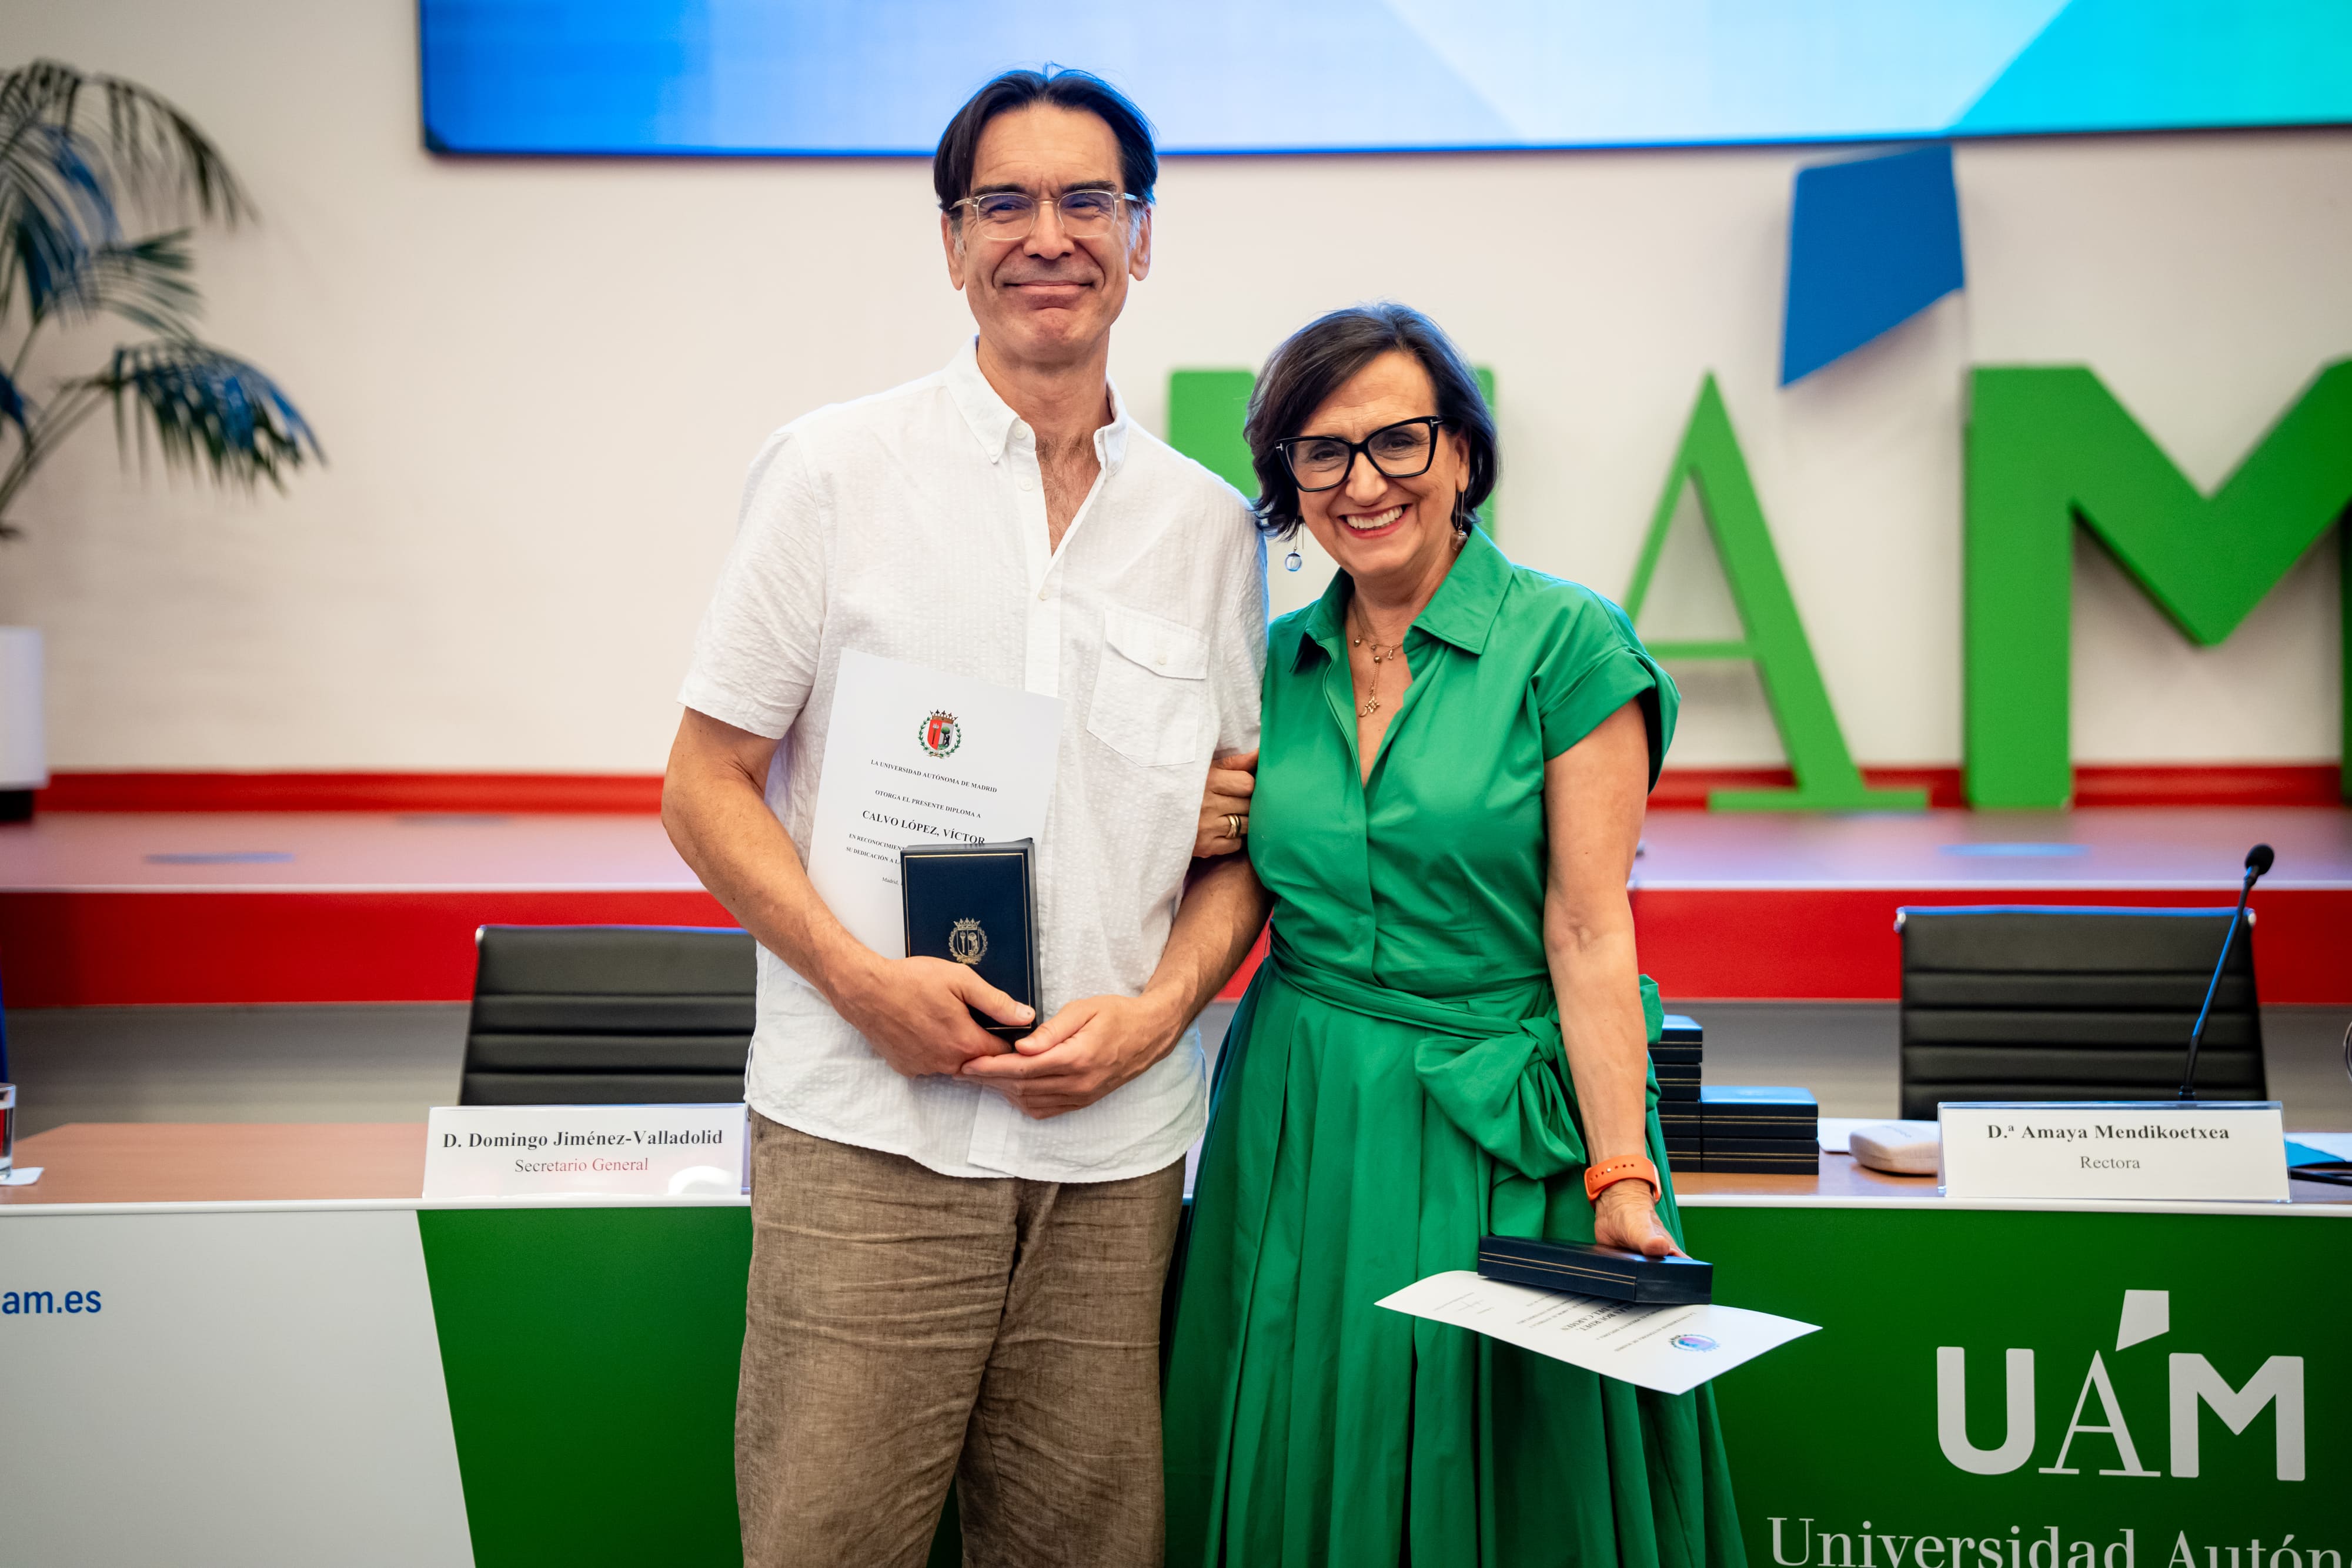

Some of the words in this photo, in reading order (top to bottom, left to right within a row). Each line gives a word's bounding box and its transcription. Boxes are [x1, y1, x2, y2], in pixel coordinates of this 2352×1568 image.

[1168, 144, 2352, 811] ÁM
[880, 761, 921, 776] UNIVERSIDAD
[923, 773, 960, 785] AUTÓNOMA
[971, 783, 997, 793] MADRID
[875, 790, 901, 801] OTORGA
[912, 798, 944, 810] PRESENTE
[946, 805, 975, 817] DIPLOMA
[863, 810, 898, 827] CALVO
[901, 820, 940, 837] LÓPEZ,
[943, 828, 985, 845] VÍCTOR
[854, 848, 889, 862] DEDICACIÓN
[882, 877, 899, 886] Madrid,
[443, 1133, 462, 1148] D.
[469, 1132, 548, 1151] Domingo
[553, 1129, 723, 1147] Jiménez-Valladolid
[2022, 1125, 2088, 1143] Amaya
[2094, 1124, 2230, 1140] Mendikoetxea
[514, 1158, 587, 1173] Secretario
[592, 1157, 649, 1172] General
[2080, 1155, 2141, 1171] Rectora
[0, 1290, 102, 1315] am.es
[1766, 1517, 2136, 1568] Universidad
[2169, 1530, 2352, 1568] Autón
